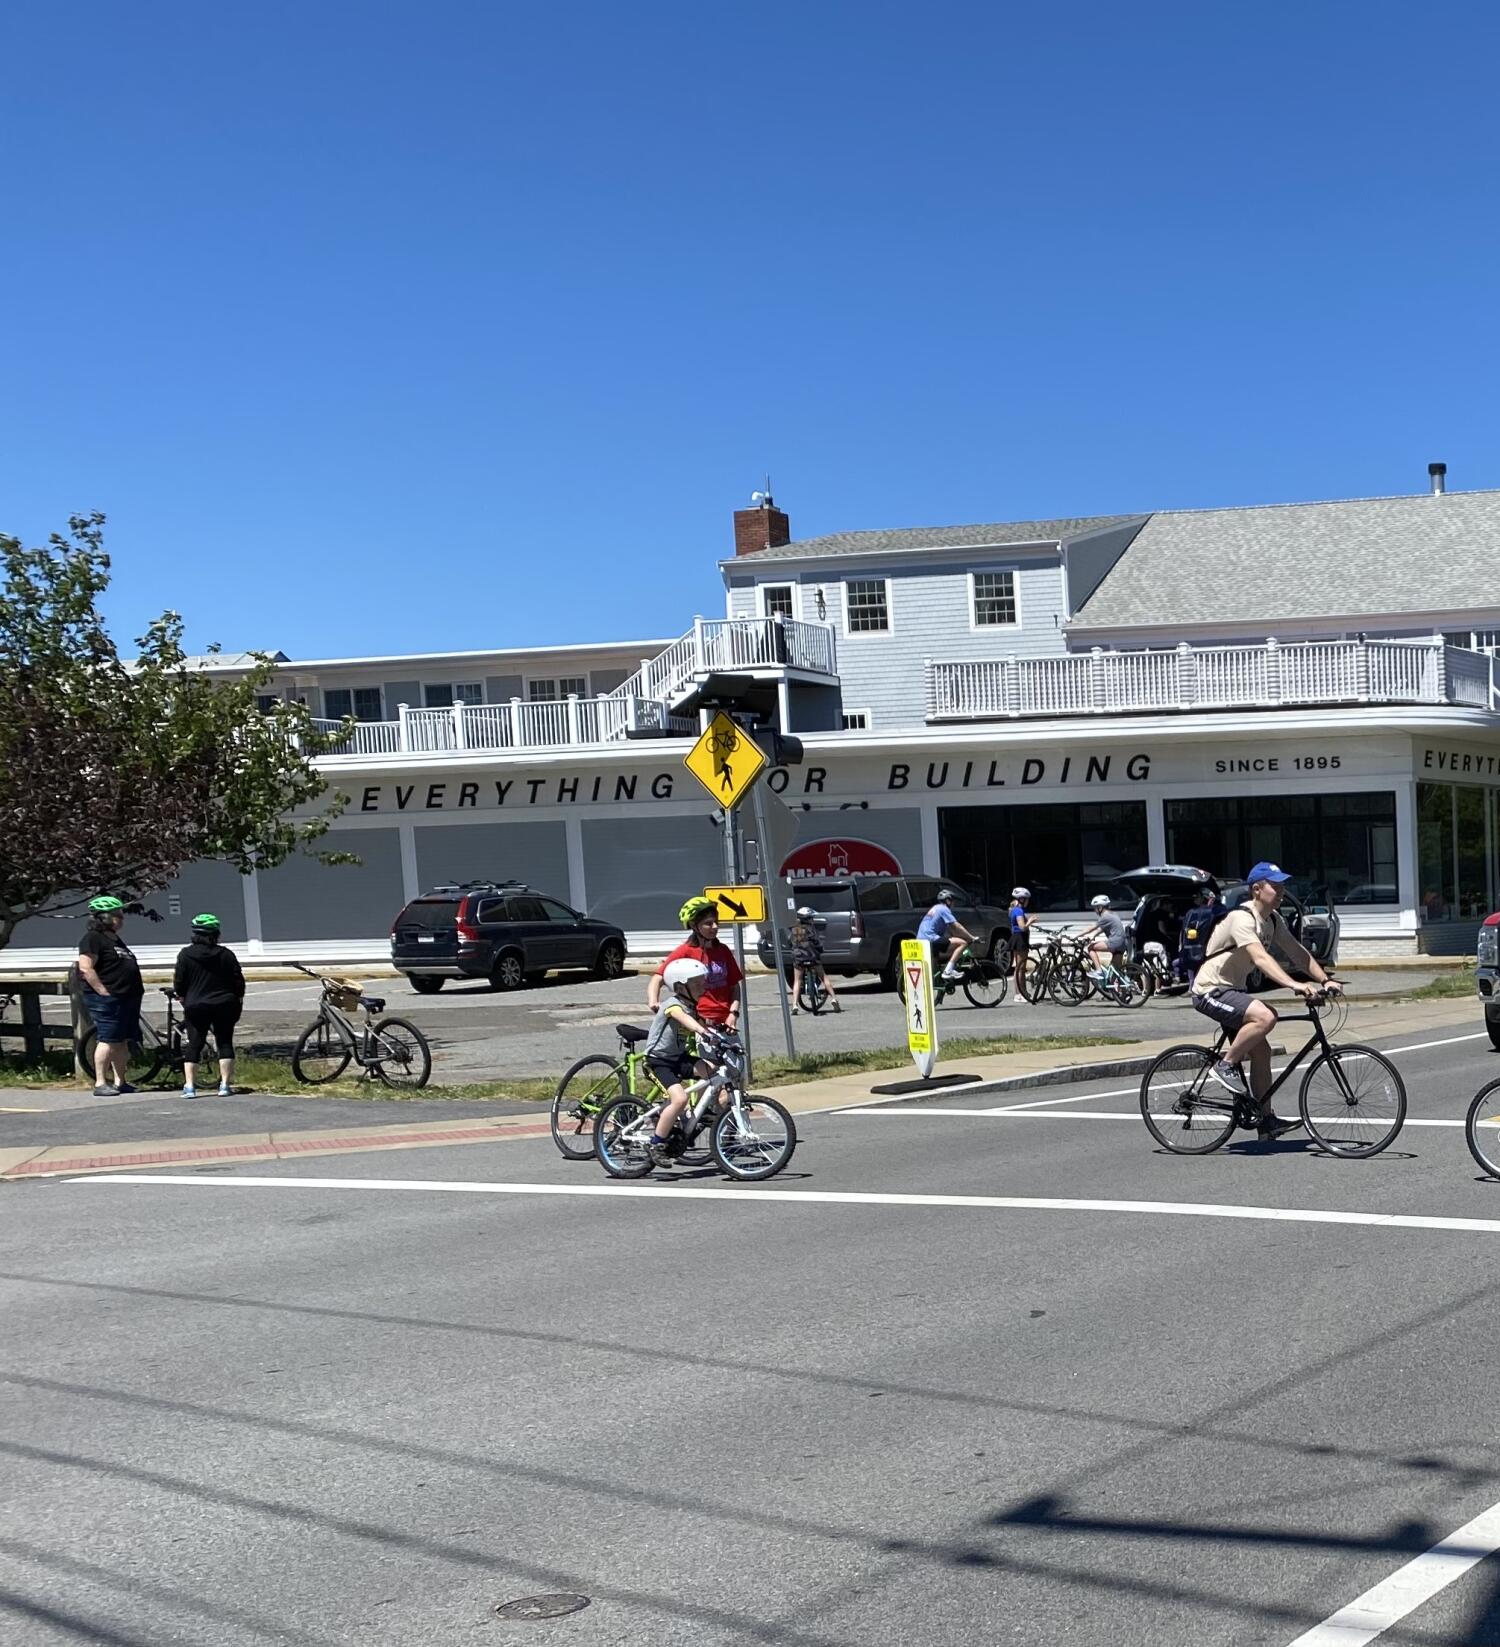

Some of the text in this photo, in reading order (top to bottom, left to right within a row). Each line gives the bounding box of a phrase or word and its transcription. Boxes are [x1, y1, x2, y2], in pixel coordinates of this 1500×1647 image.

[1215, 756, 1341, 773] SINCE 1895
[361, 754, 1152, 811] EVERYTHING OR BUILDING
[904, 942, 919, 950] STATE
